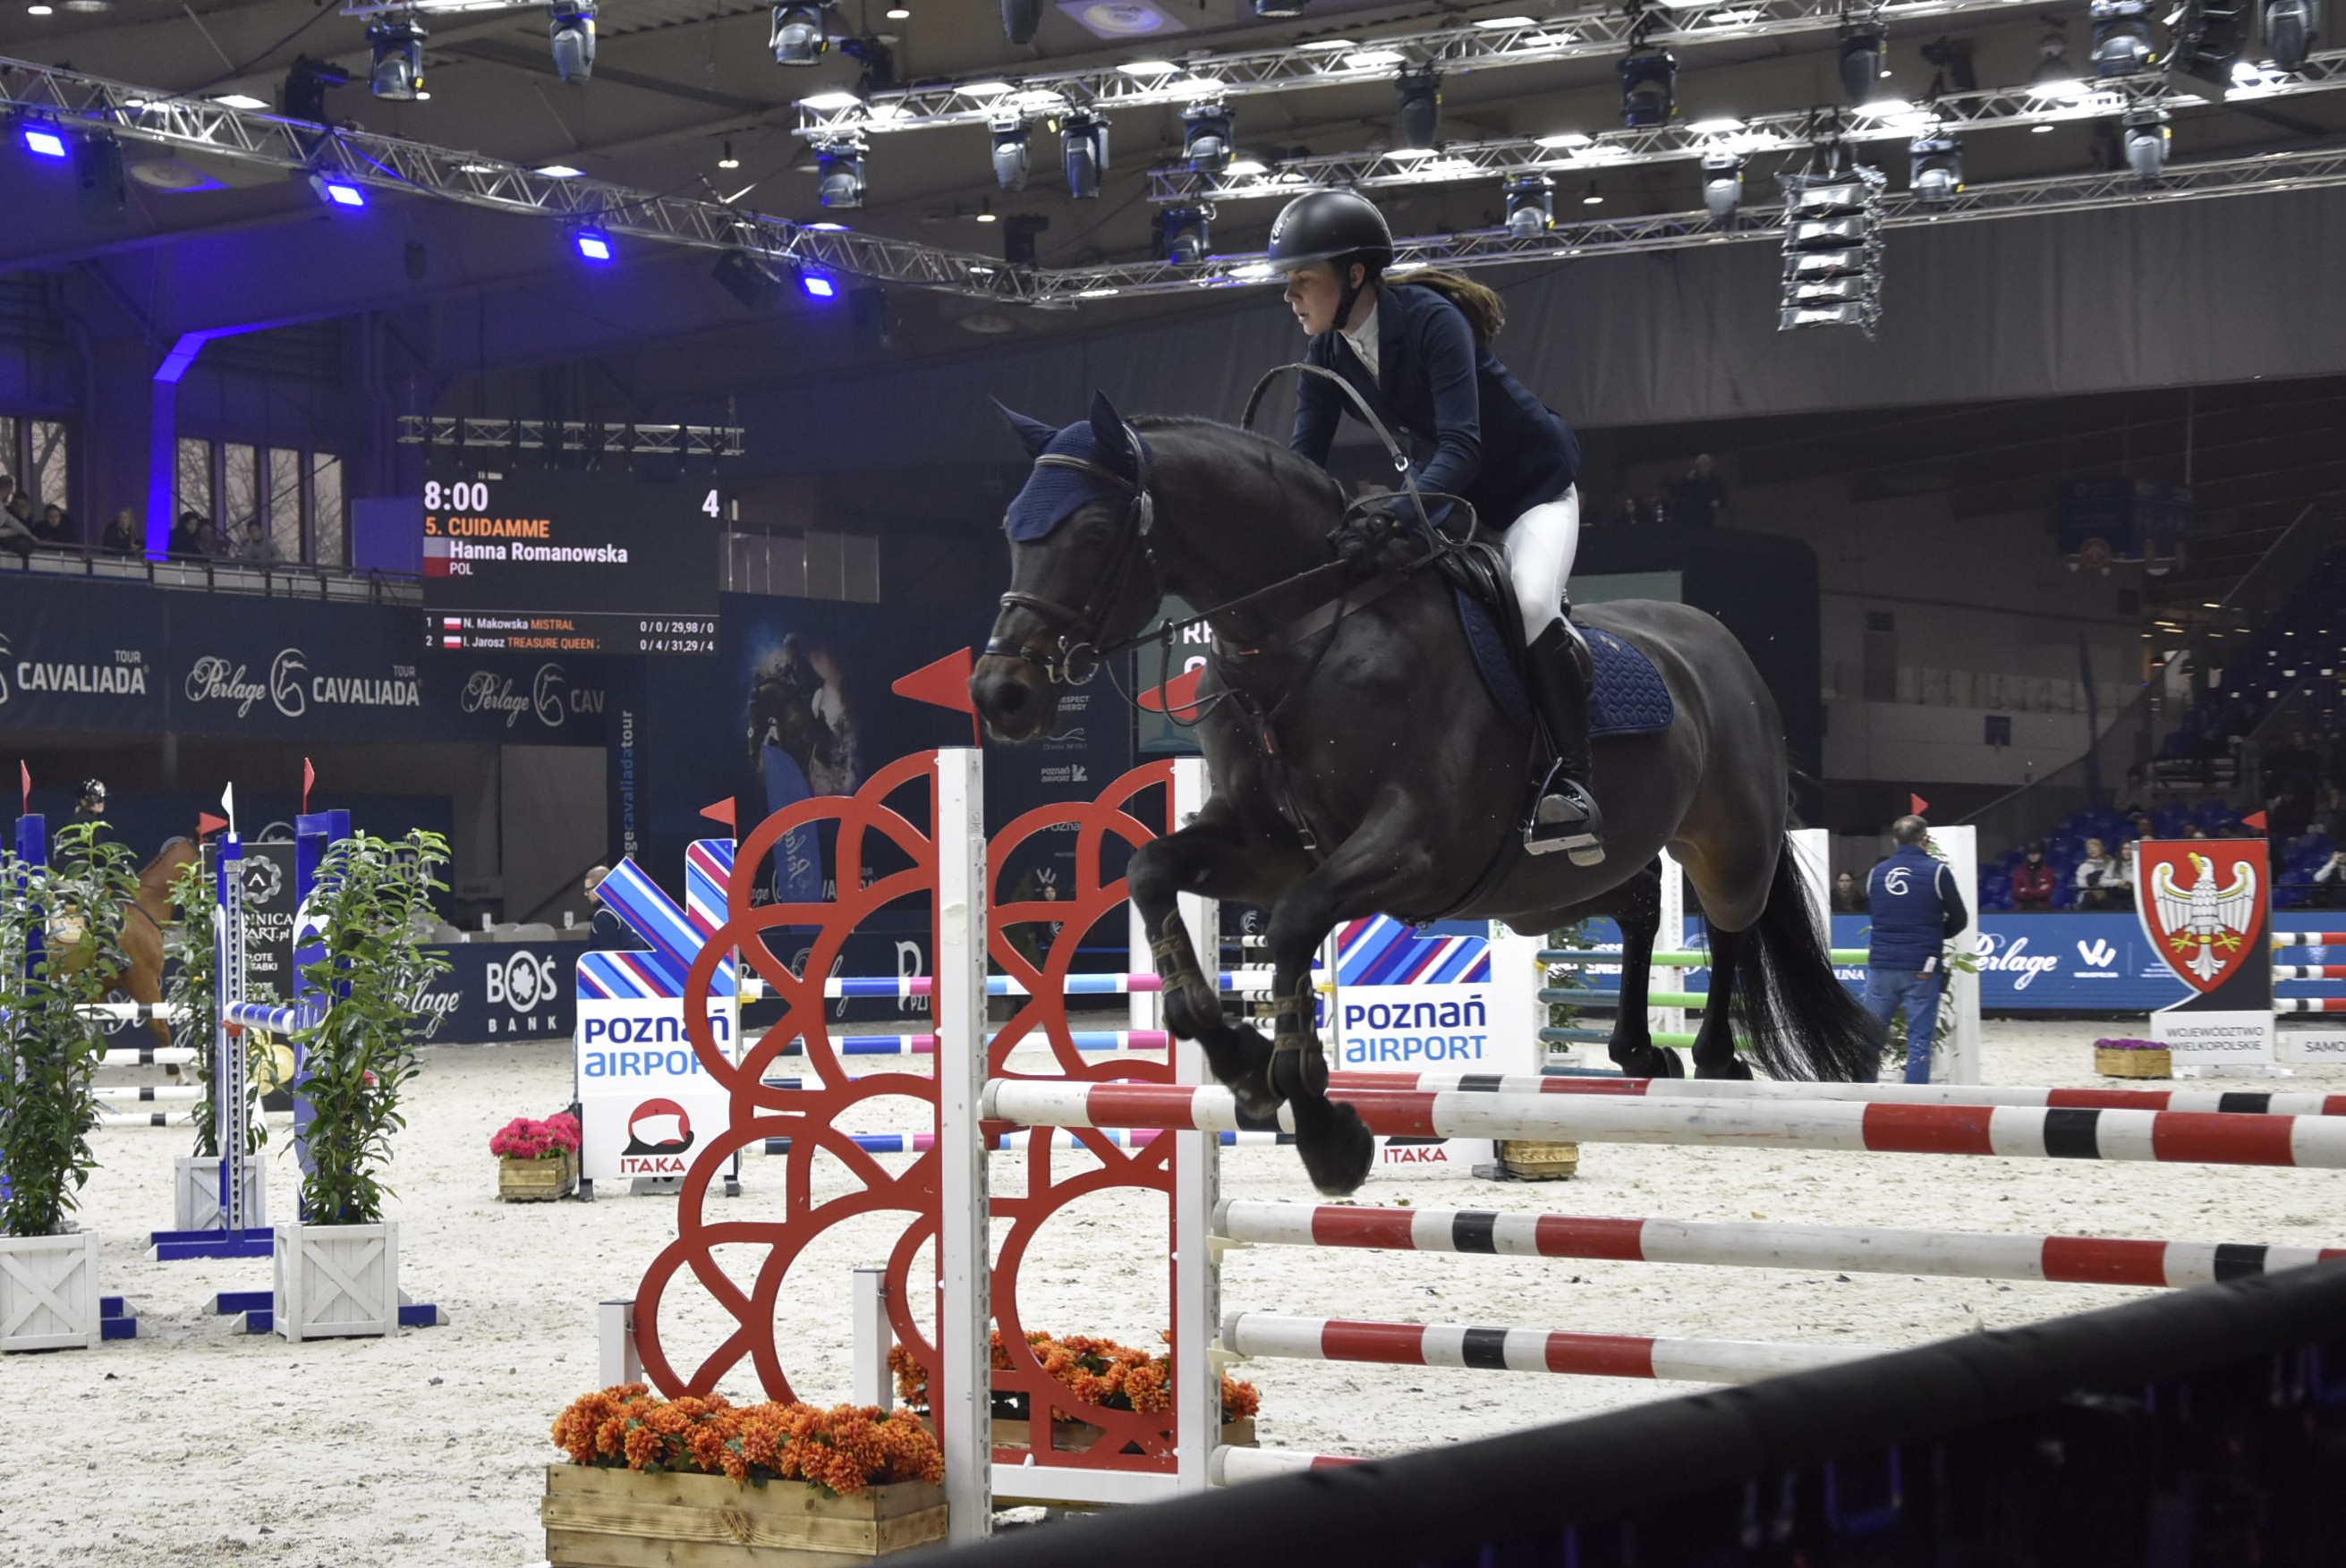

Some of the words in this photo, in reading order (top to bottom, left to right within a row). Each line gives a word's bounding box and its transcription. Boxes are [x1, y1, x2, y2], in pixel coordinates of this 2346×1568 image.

[424, 480, 489, 512] 8:00
[702, 489, 719, 518] 4
[425, 516, 442, 536] 5.
[448, 517, 550, 538] CUIDAMME
[450, 540, 506, 560] Hanna
[512, 542, 628, 563] Romanowska
[450, 562, 474, 575] POL
[426, 617, 432, 628] 1
[463, 617, 474, 629] N.
[477, 618, 529, 630] Makowska
[531, 619, 574, 631] MISTRAL
[640, 621, 647, 631] 0
[656, 622, 663, 632] 0
[671, 622, 698, 634] 29,98
[707, 623, 714, 633] 0
[426, 636, 432, 646] 2
[472, 637, 505, 648] Jarosz
[507, 637, 558, 648] TREASURE
[561, 638, 594, 650] QUEEN
[640, 640, 647, 650] 0
[655, 640, 663, 650] 4
[671, 640, 698, 652] 31,29
[707, 640, 714, 651] 4
[115, 649, 141, 663] TOUR
[17, 662, 146, 694] CAVALIADA
[393, 665, 416, 677] TOUR
[185, 656, 267, 718] Perlage
[313, 676, 420, 707] CAVALIADA
[461, 671, 529, 728] Perlage
[1975, 931, 2058, 991] Perlage
[486, 950, 557, 1013] BOŚ
[489, 1015, 557, 1033] BANK
[2165, 1024, 2265, 1038] WOJEWÓDZTWO
[2169, 1040, 2263, 1053] WIELKOPOLSKIE
[1383, 1147, 1448, 1164] ITAKA
[620, 1157, 686, 1174] ITAKA
